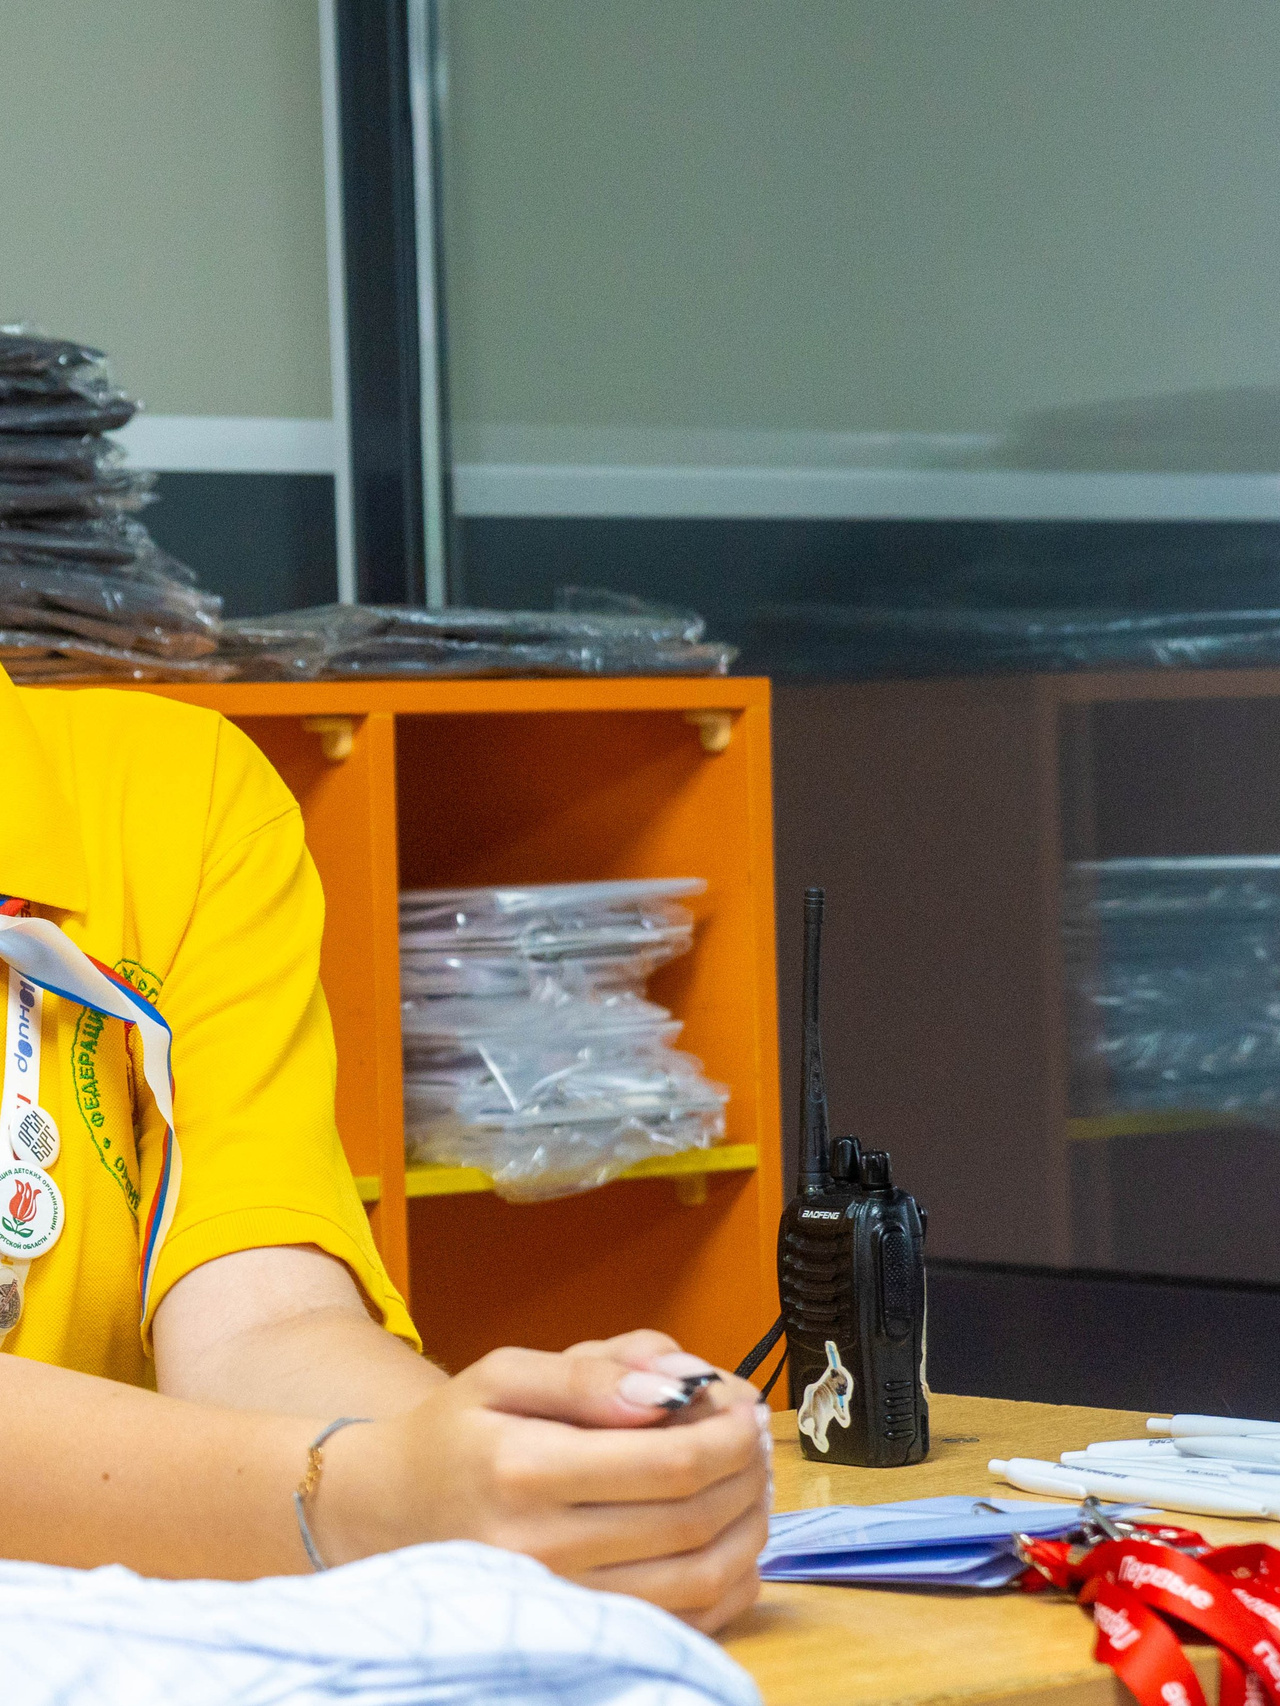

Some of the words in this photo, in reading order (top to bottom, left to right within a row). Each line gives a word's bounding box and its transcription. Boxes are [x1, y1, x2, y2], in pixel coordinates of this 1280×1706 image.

[78, 1008, 108, 1128] ФЕДЕРАЦИ
[18, 1110, 46, 1148] ОРЕН
[13, 1168, 42, 1181] ДЕТСКИХ
[42, 1179, 59, 1231] ОРГАНИЗАЦИЙ
[801, 1209, 840, 1220] BAOFENG
[22, 1235, 48, 1250] ОБЛАСТИ
